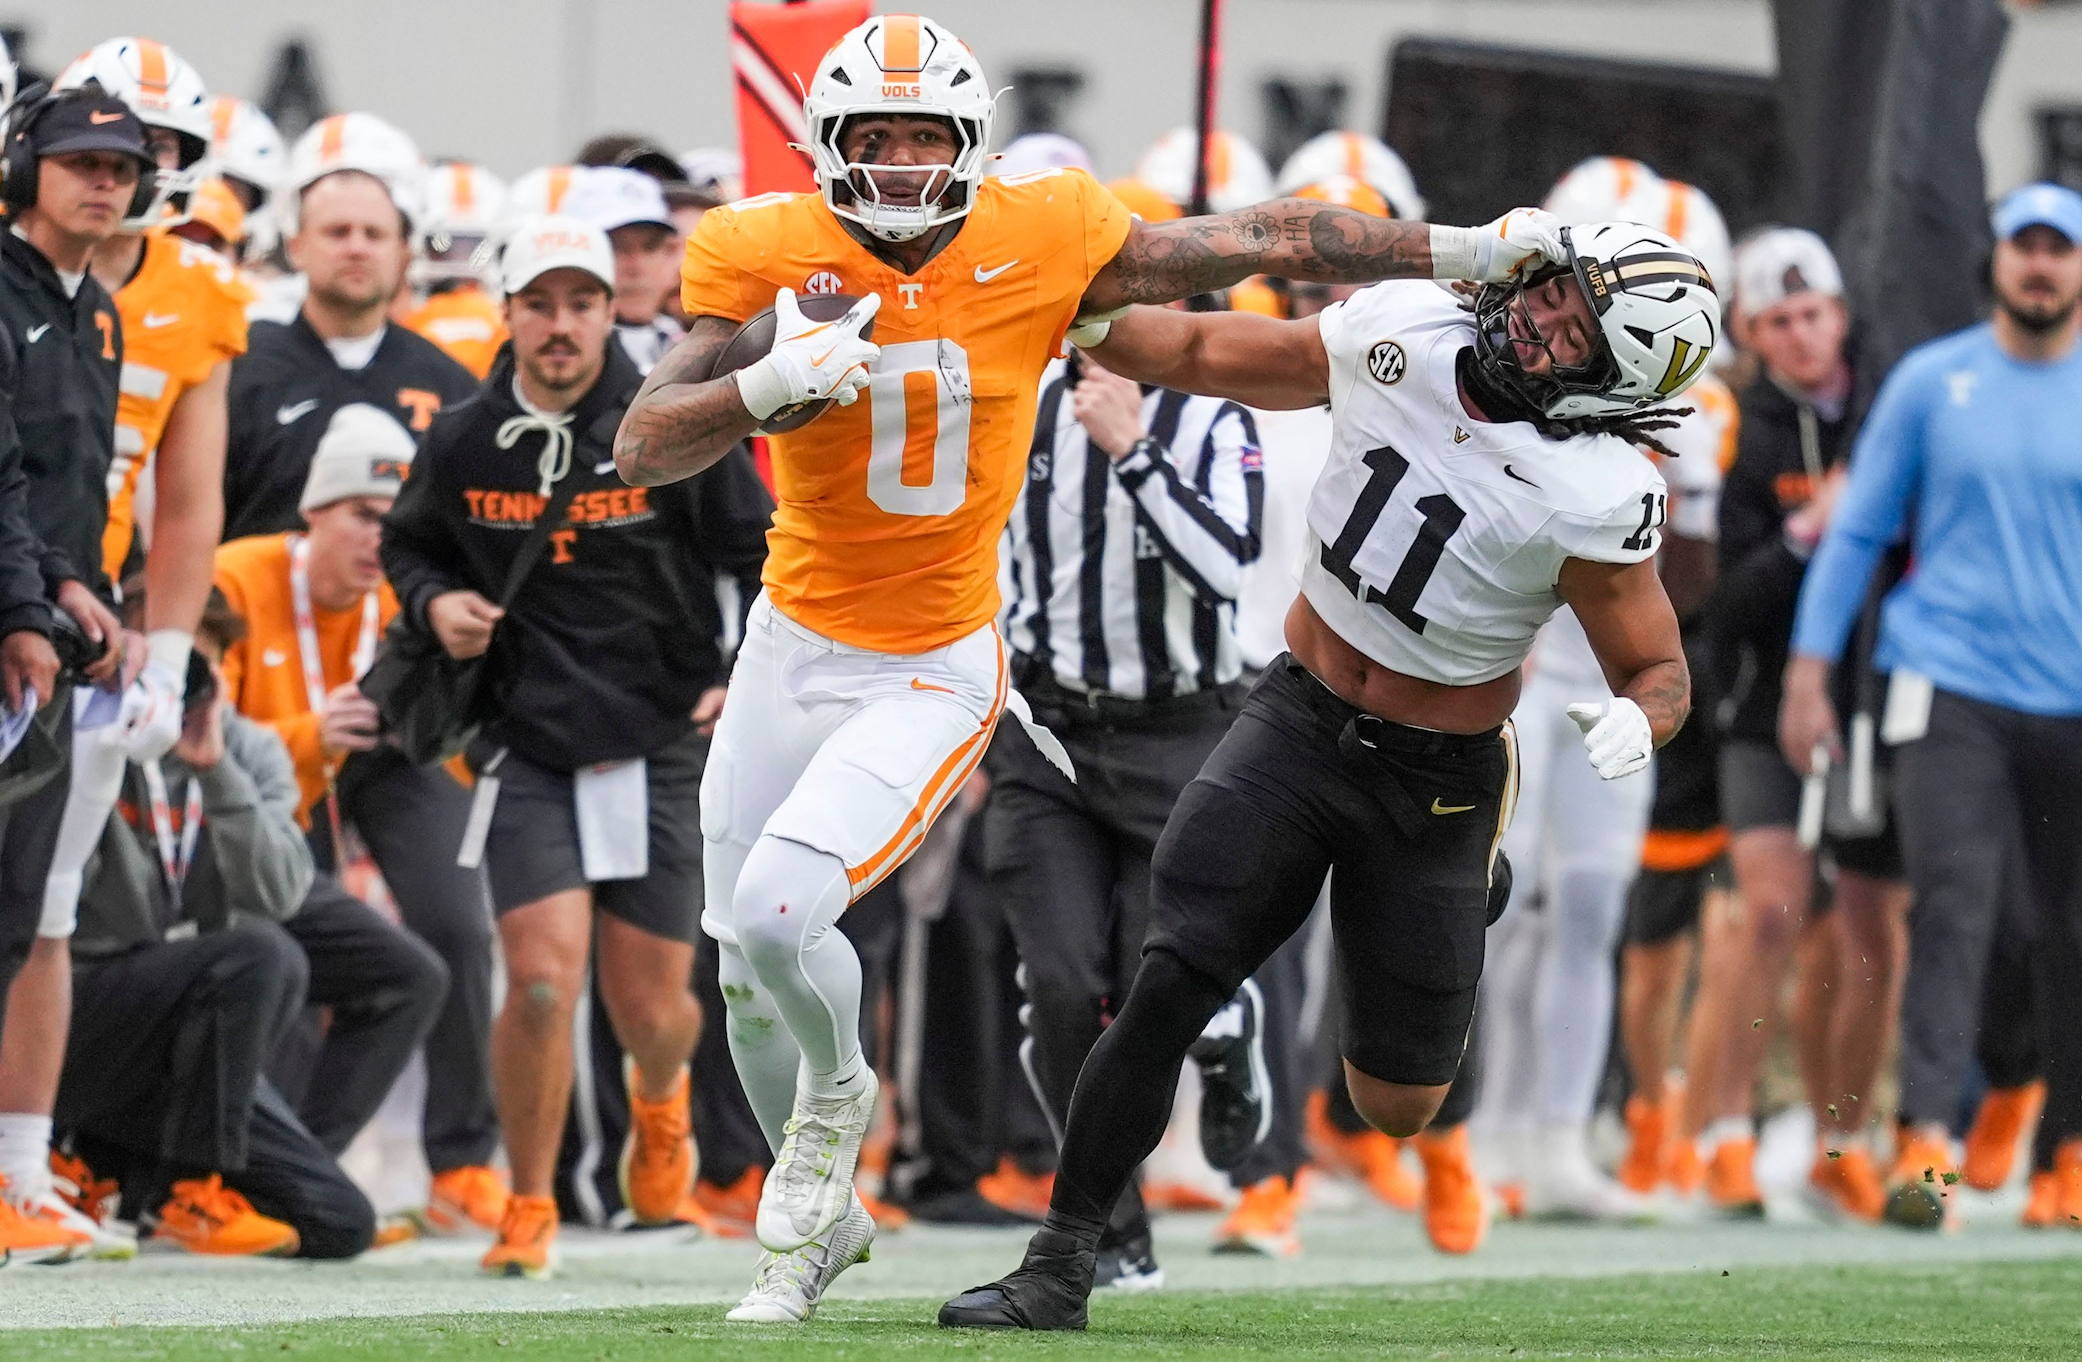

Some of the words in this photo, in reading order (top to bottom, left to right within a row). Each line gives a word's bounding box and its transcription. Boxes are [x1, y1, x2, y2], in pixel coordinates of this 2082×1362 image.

[882, 86, 920, 97] VOLS
[898, 283, 923, 309] T
[1587, 263, 1607, 297] VUFB
[1369, 343, 1403, 382] SEC
[1654, 334, 1711, 395] V
[397, 387, 441, 431] T
[868, 338, 970, 515] 0
[1454, 425, 1470, 444] V
[463, 487, 650, 523] TENNSSEE
[1622, 492, 1665, 551] 11
[551, 528, 577, 564] T
[1321, 446, 1466, 635] 11
